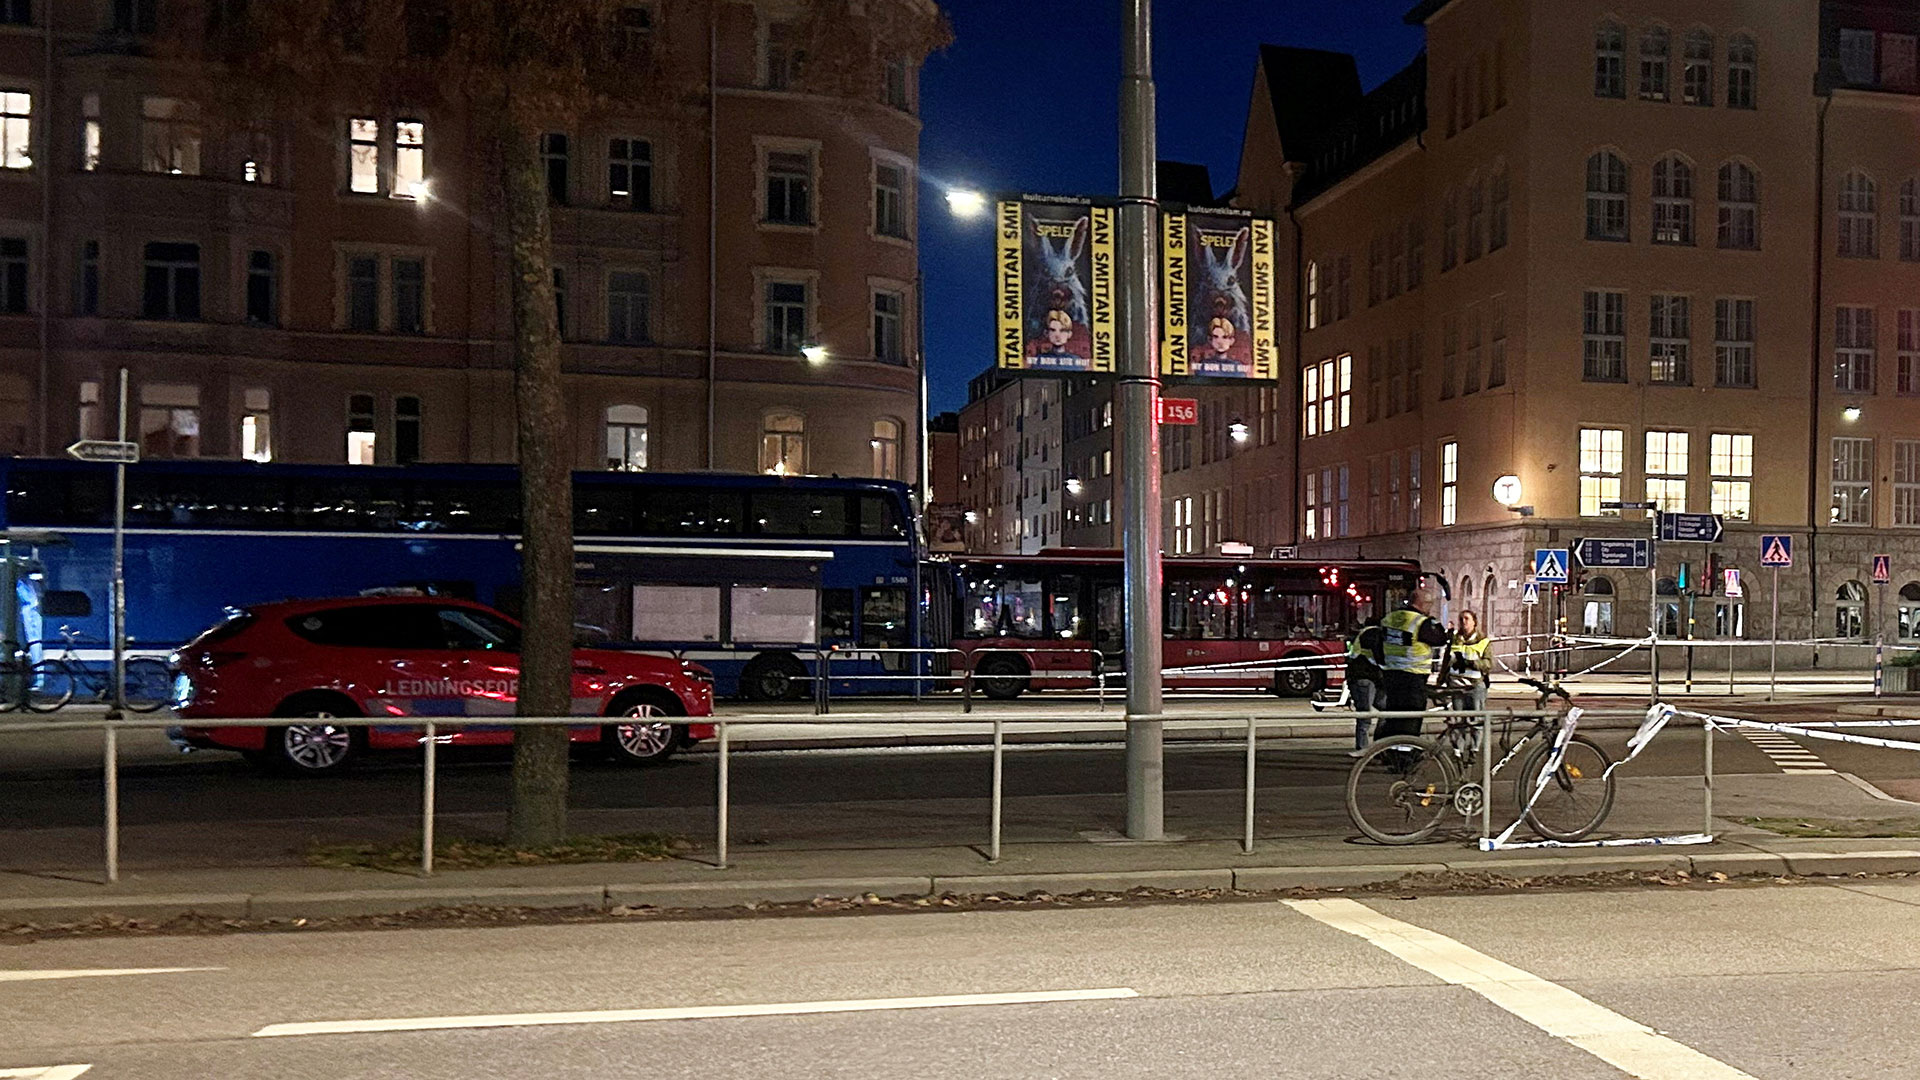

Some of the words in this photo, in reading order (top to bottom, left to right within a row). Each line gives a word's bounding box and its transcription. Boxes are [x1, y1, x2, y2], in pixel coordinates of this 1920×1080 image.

[1004, 247, 1019, 319] SMITTAN
[1095, 252, 1109, 323] SMITTAN
[1168, 257, 1183, 326] SMITTAN
[1254, 262, 1268, 330] SMITTAN
[1168, 406, 1193, 420] 15,6
